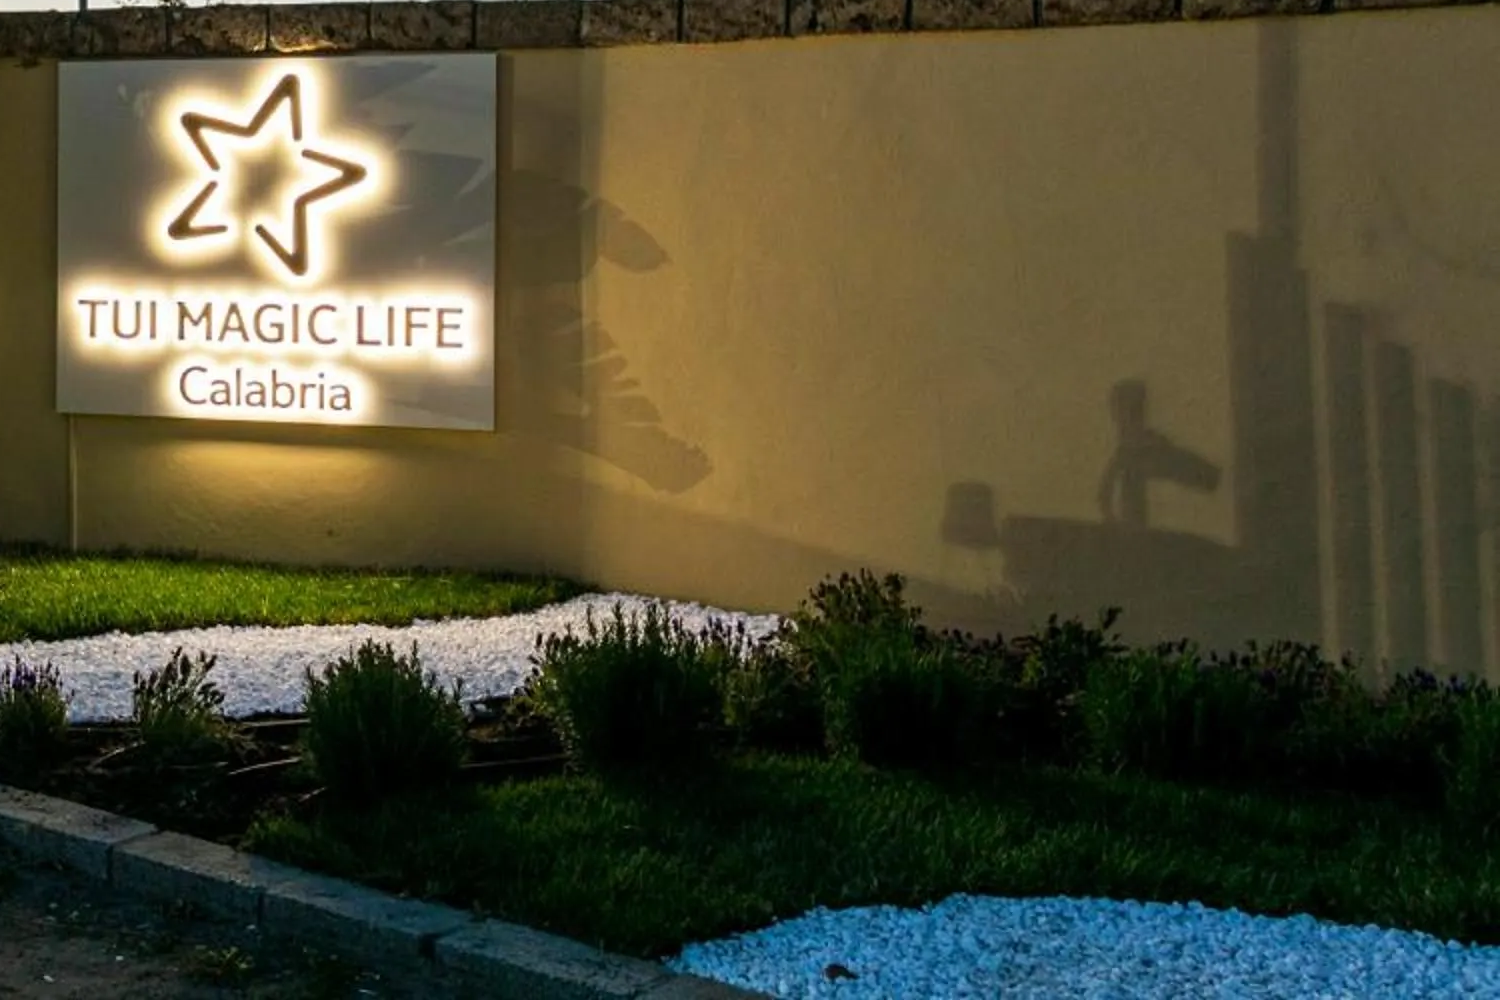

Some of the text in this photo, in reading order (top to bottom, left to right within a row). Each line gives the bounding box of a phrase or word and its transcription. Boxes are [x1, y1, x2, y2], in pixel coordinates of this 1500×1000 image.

[78, 299, 465, 349] TUI MAGIC LIFE
[179, 366, 353, 411] Calabria
